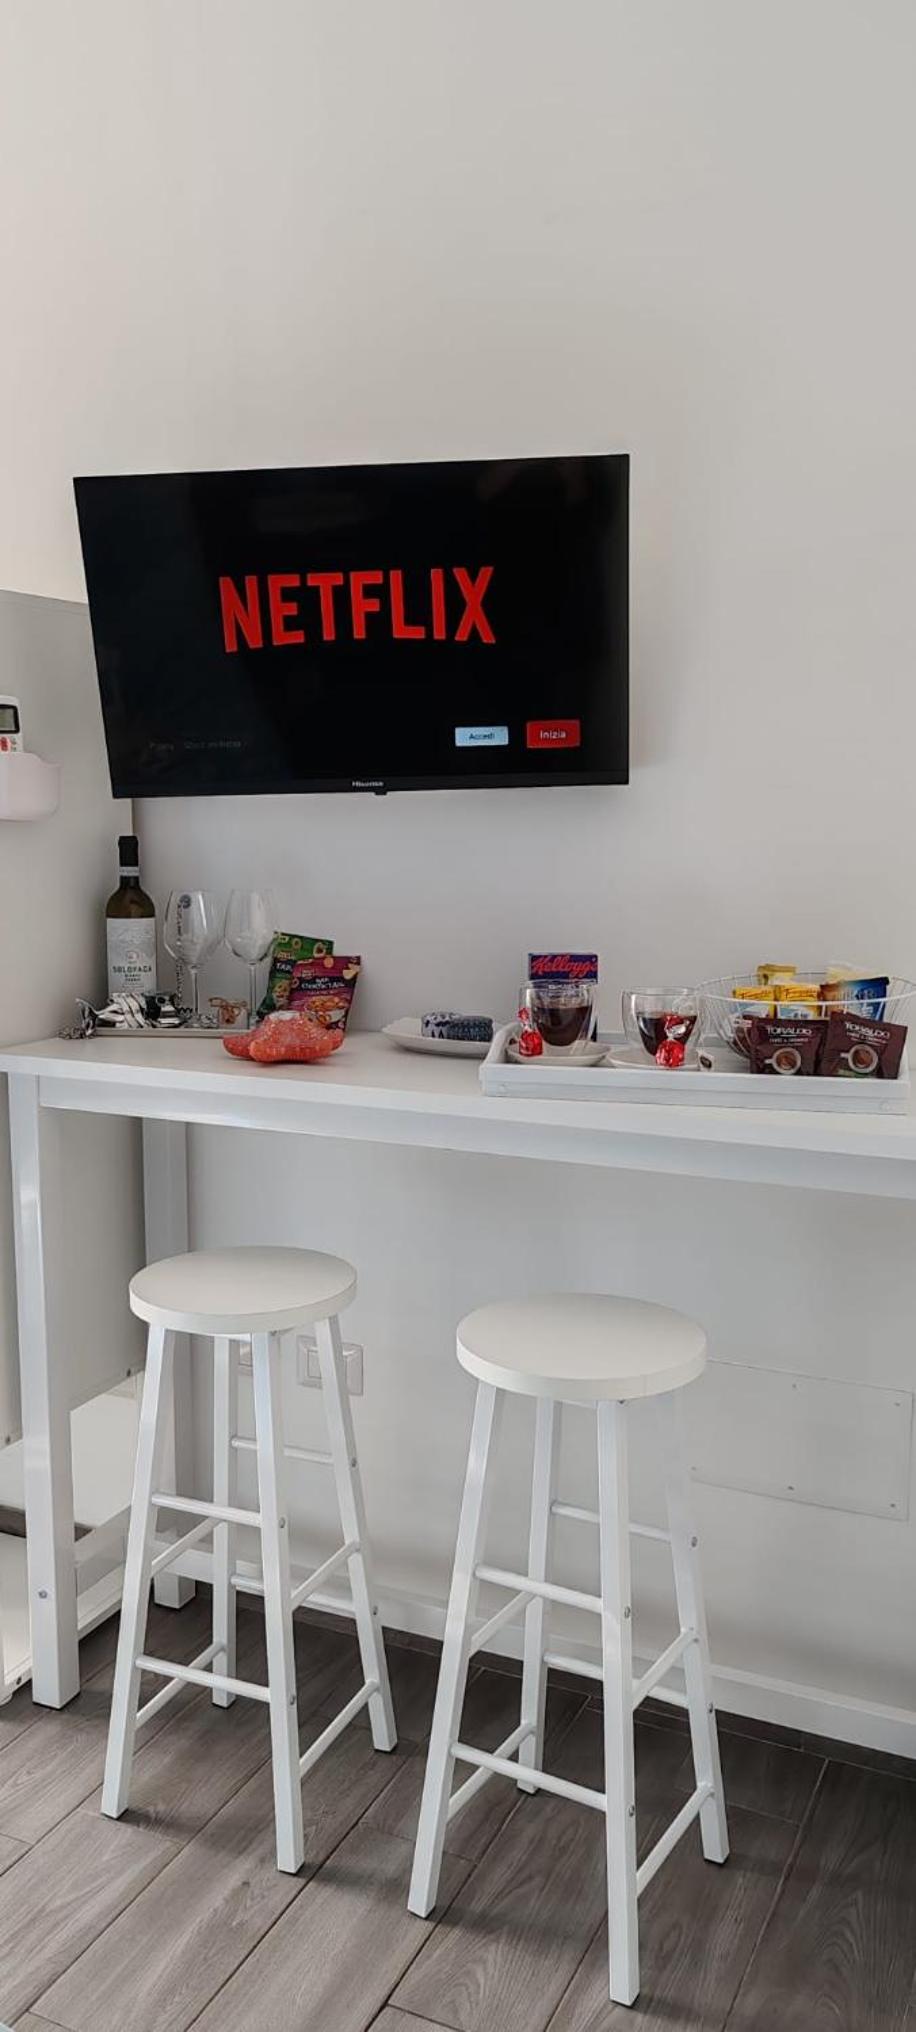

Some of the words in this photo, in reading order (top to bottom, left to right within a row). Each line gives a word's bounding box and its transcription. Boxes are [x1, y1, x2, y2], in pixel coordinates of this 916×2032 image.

[219, 566, 496, 653] NETFLIX
[540, 729, 566, 740] Inizia
[530, 954, 598, 979] Kellogg's
[766, 1026, 813, 1036] TORALDO
